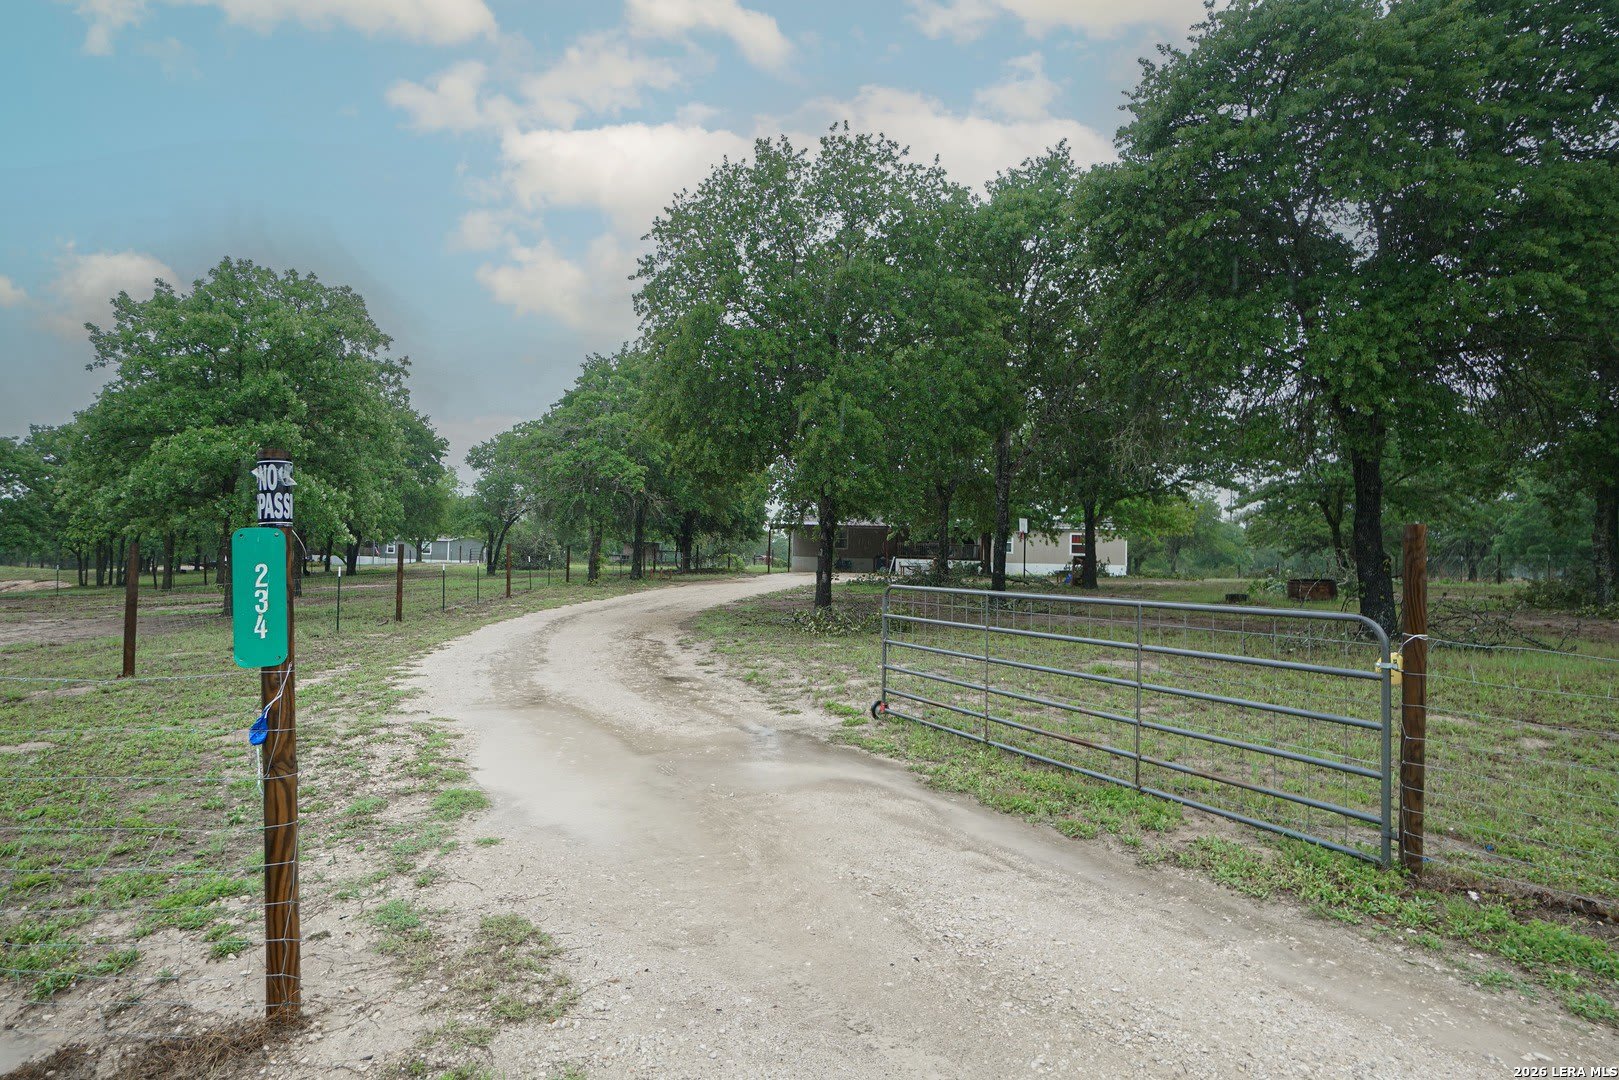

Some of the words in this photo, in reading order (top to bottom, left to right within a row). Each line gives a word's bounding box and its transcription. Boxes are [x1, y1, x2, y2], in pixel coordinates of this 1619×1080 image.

[258, 464, 278, 491] NO
[257, 492, 293, 519] PASSI
[254, 563, 268, 639] 234
